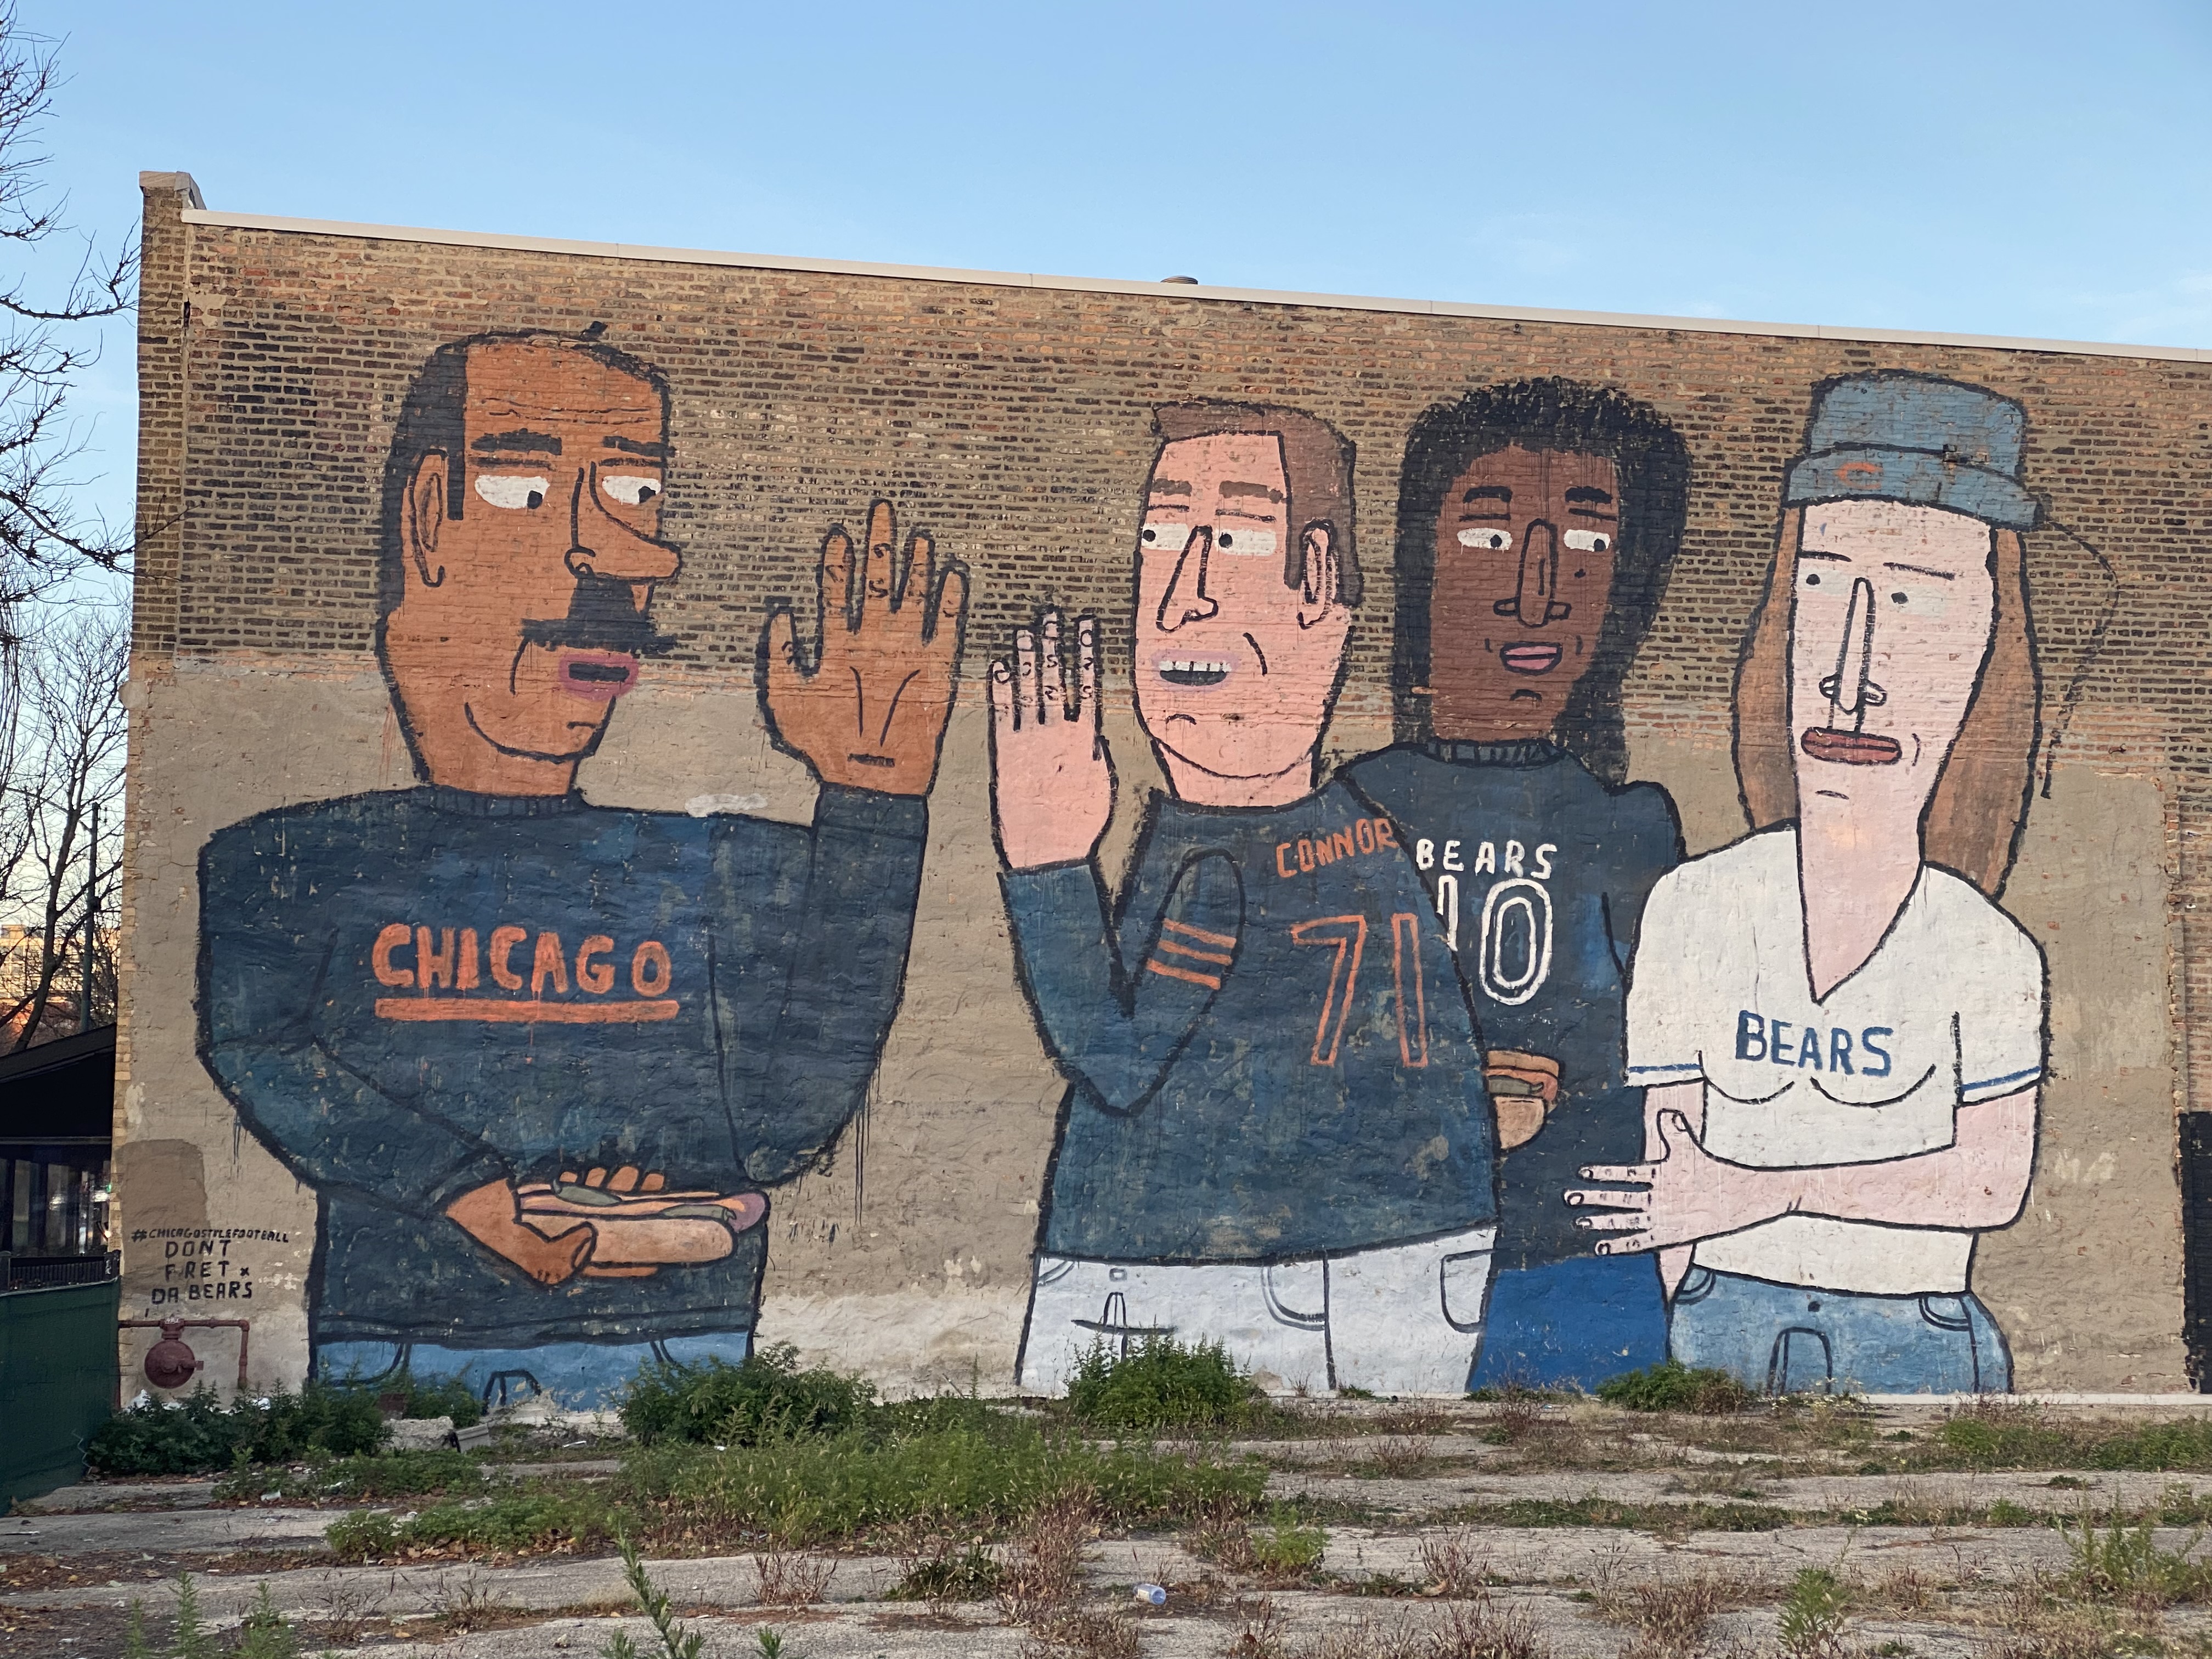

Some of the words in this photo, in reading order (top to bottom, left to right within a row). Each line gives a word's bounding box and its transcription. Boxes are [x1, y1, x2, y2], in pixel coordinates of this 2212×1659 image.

[1276, 818, 1400, 878] CONNOR
[1416, 838, 1558, 879] BEARS
[372, 923, 672, 997] CHICAGO
[1436, 874, 1554, 1006] 10
[1290, 913, 1428, 1068] 71
[1735, 1009, 1894, 1077] BEARS
[165, 1239, 231, 1258] DONT
[165, 1260, 230, 1282] FRET
[151, 1287, 179, 1305] DA
[188, 1281, 253, 1300] BEARS
